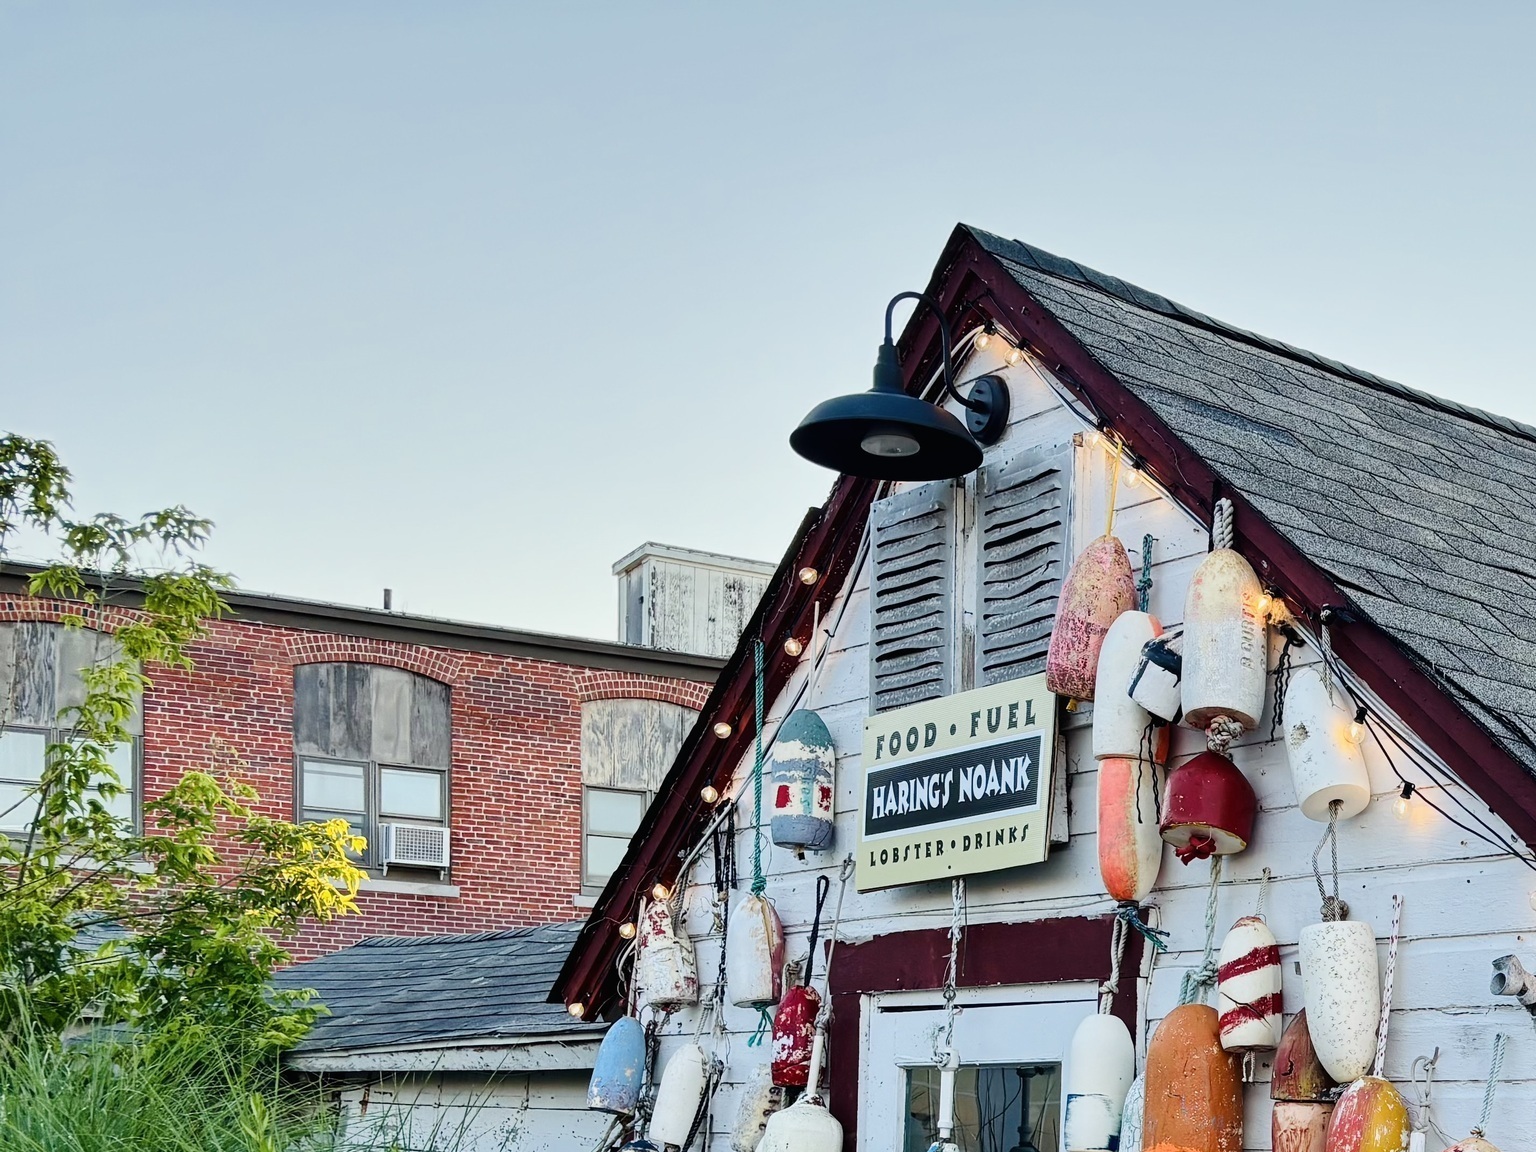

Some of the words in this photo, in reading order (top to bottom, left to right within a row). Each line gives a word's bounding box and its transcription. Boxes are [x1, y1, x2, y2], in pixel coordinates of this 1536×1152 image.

[875, 722, 938, 760] FOOD
[970, 699, 1036, 738] FUEL
[871, 767, 954, 820] HARING'S
[957, 753, 1032, 804] NOANK
[870, 839, 944, 867] LOBSTER
[962, 823, 1029, 852] DRINKS
